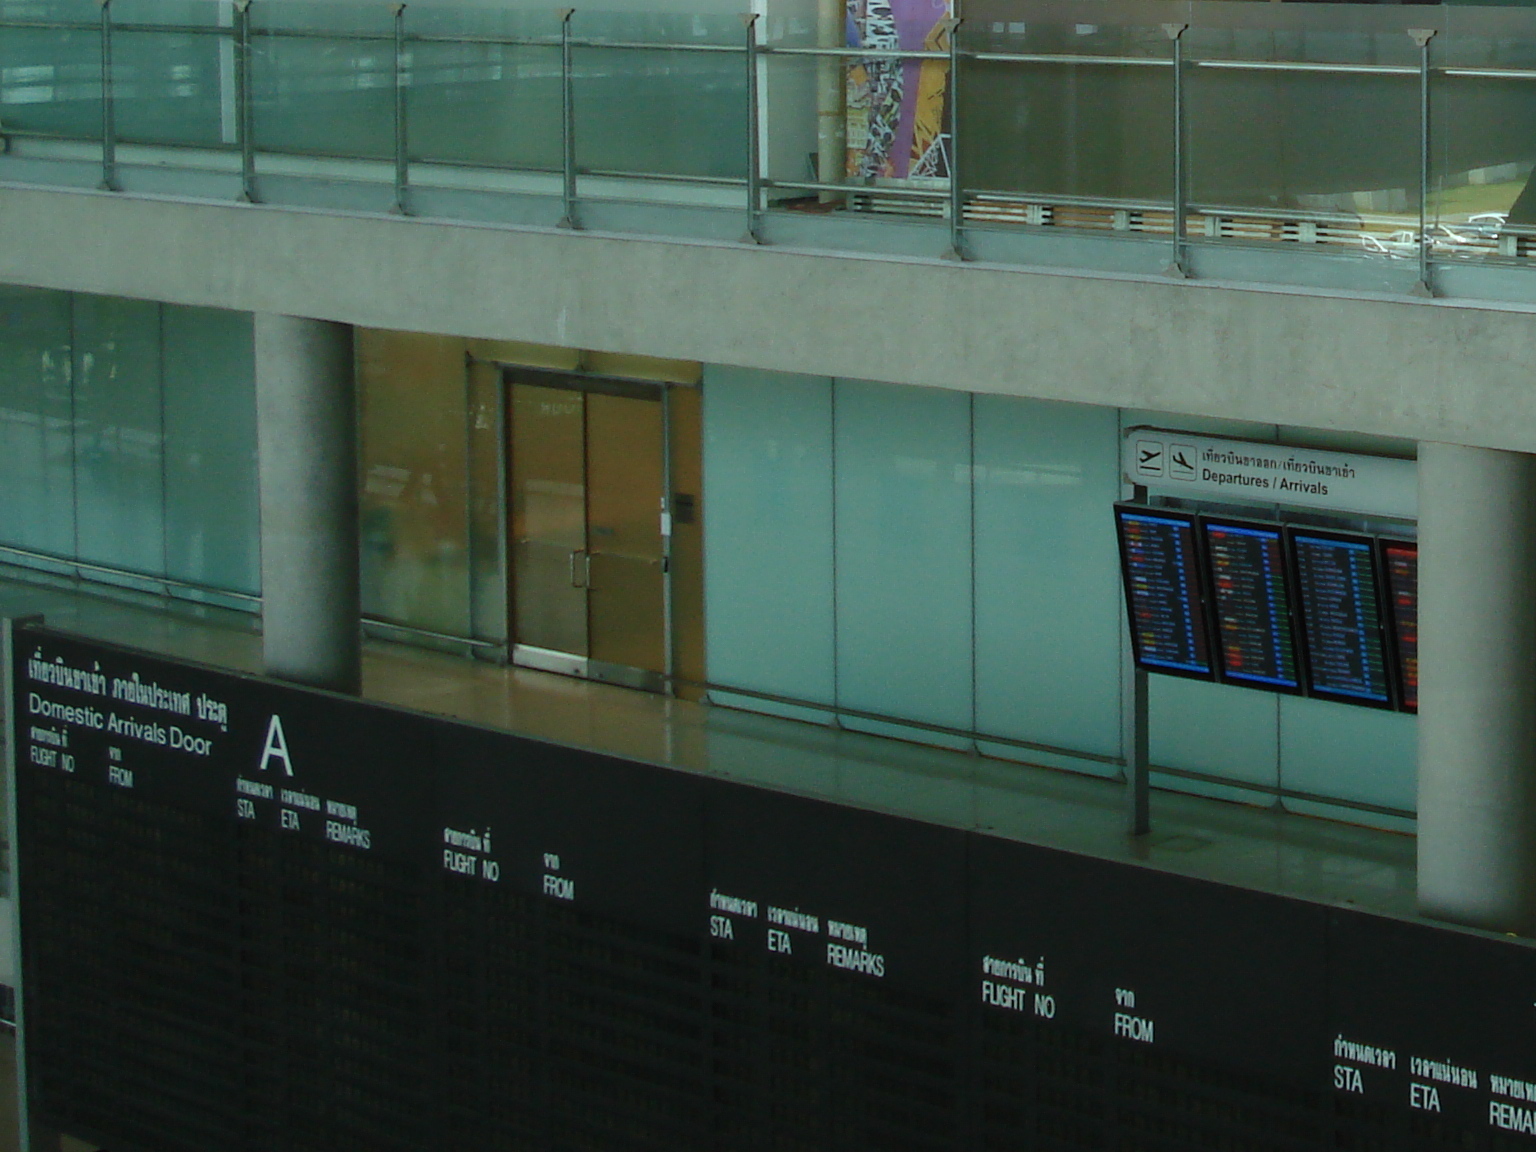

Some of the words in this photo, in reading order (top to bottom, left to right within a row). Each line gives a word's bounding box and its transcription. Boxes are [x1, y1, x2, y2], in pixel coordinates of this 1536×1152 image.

[1203, 468, 1269, 488] Departures
[1280, 477, 1328, 495] Arrivals
[29, 693, 104, 729] Domestic
[107, 712, 167, 745] Arrivals
[169, 726, 213, 756] Door
[31, 745, 57, 768] FLIGHT
[260, 714, 294, 776] A
[108, 765, 134, 788] FROM
[237, 798, 255, 819] STA
[281, 808, 299, 831] ETA
[326, 820, 370, 849] REMARKS
[444, 849, 477, 875] FLIGHT
[482, 859, 499, 881] NO
[543, 874, 574, 900] FROM
[710, 915, 734, 940] STA
[767, 929, 792, 955] ETA
[827, 943, 885, 977] REMARKS
[982, 980, 1026, 1011] FLIGHT
[1034, 993, 1056, 1019] NO
[1114, 1012, 1154, 1043] FROM
[1334, 1064, 1364, 1094] STA
[1410, 1082, 1441, 1113] ETA
